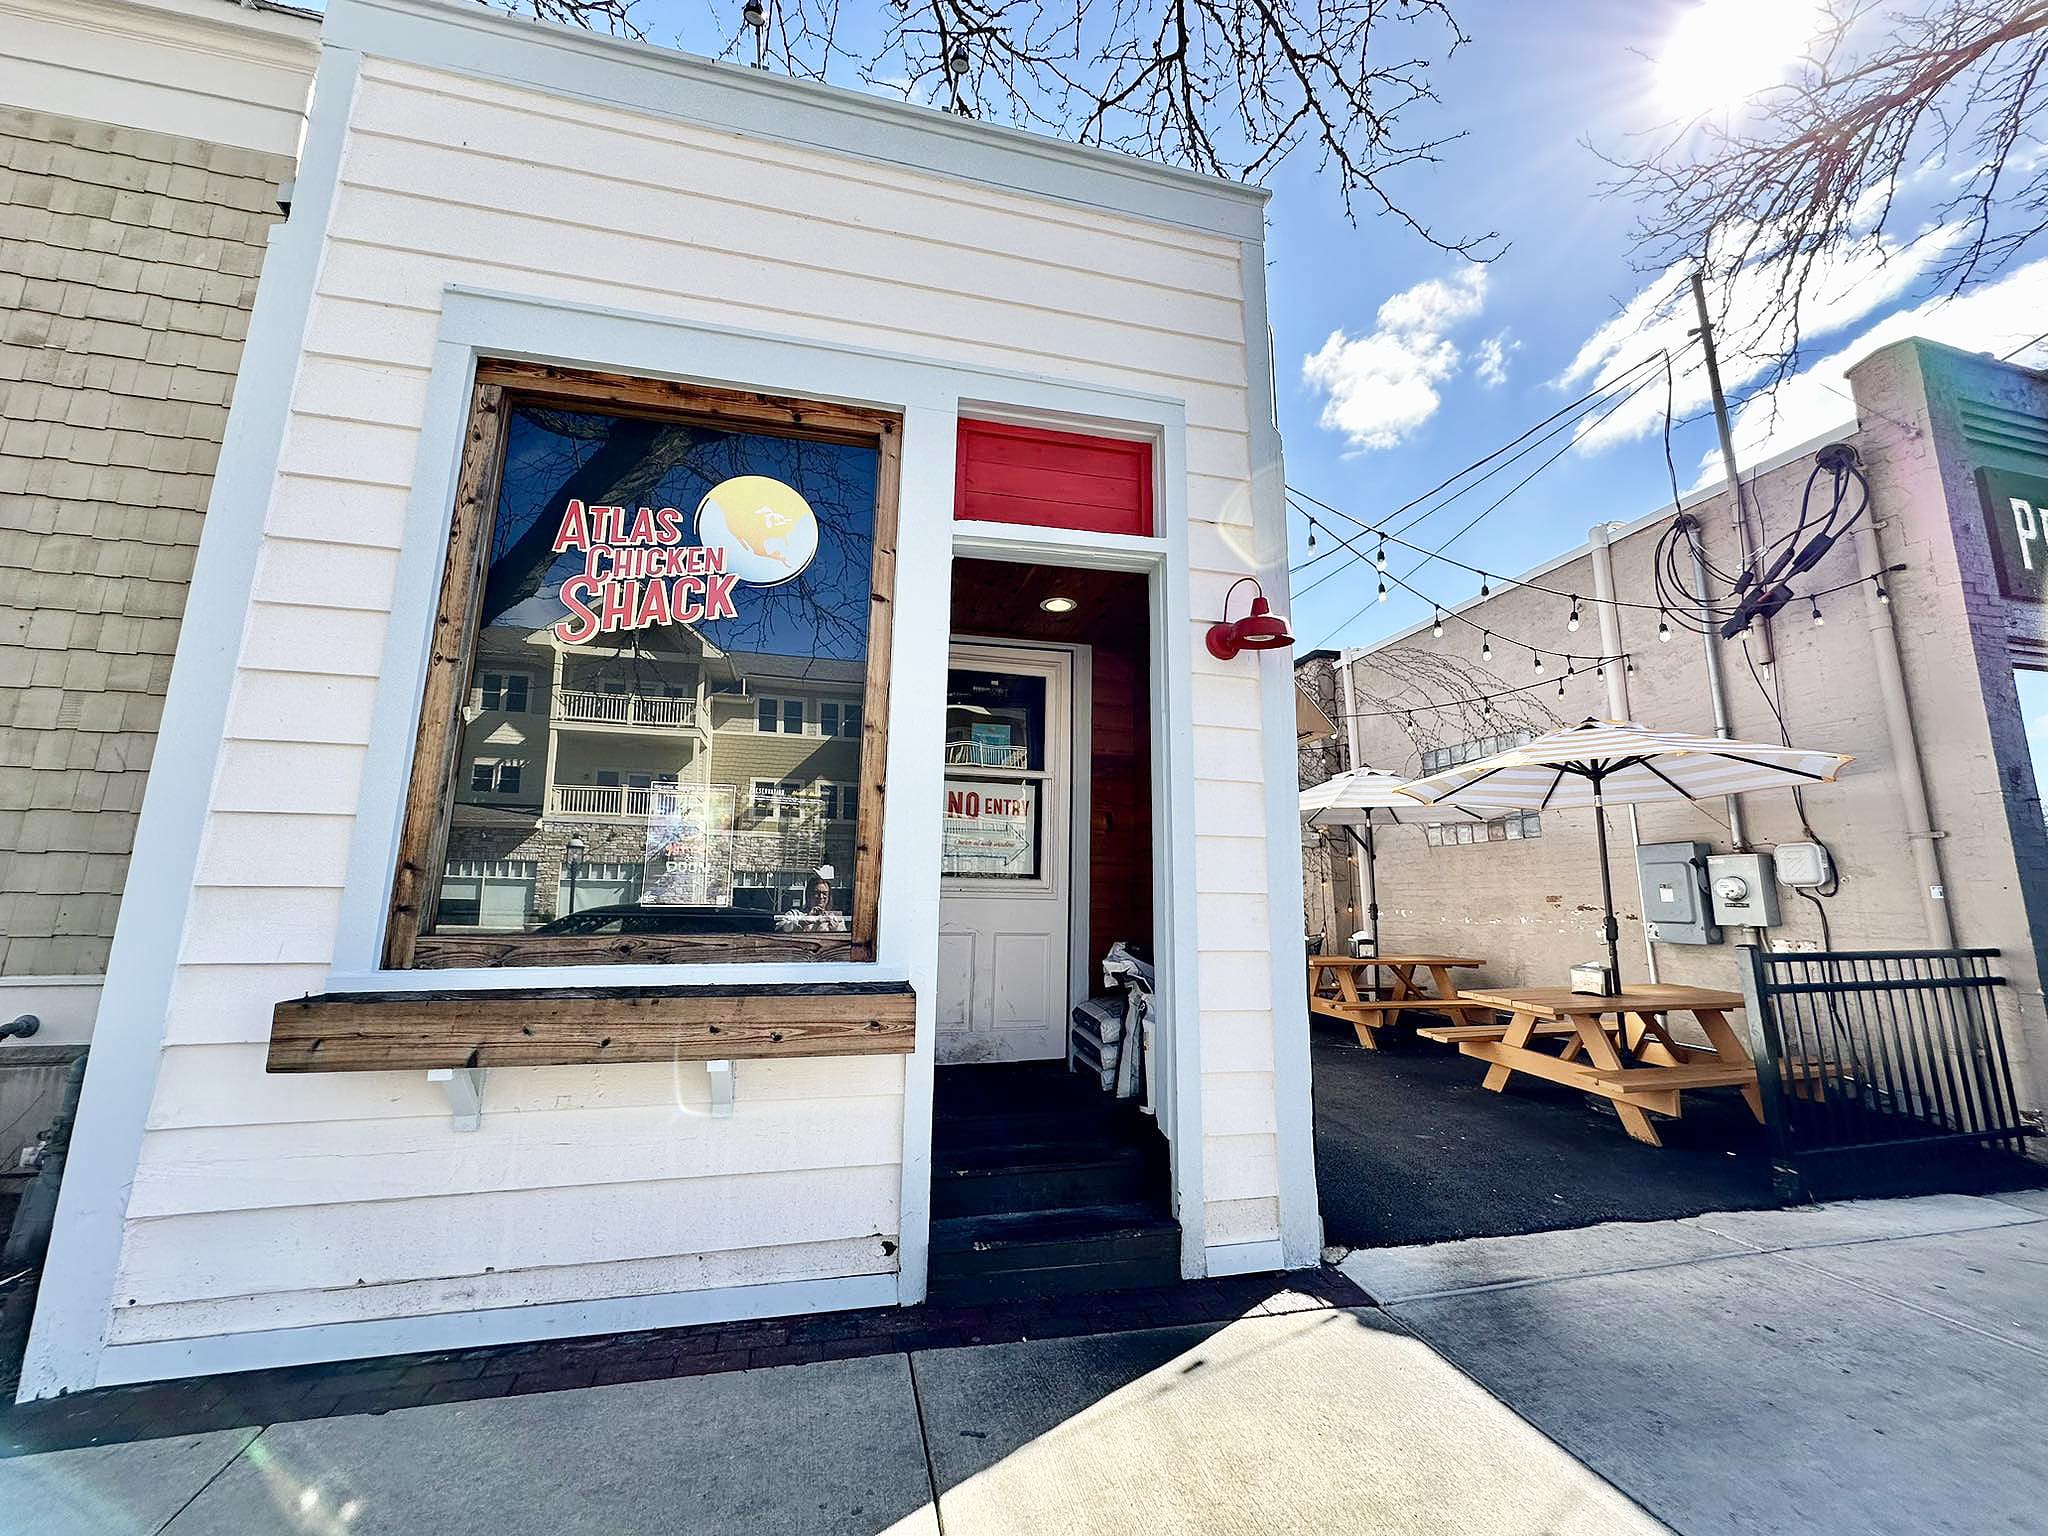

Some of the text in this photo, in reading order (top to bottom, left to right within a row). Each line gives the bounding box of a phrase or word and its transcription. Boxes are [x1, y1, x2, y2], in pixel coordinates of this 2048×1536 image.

[553, 499, 683, 552] ATLAS
[585, 544, 727, 583] CHICKEN
[554, 574, 739, 644] SHACK
[947, 791, 1030, 818] NO ENTRY
